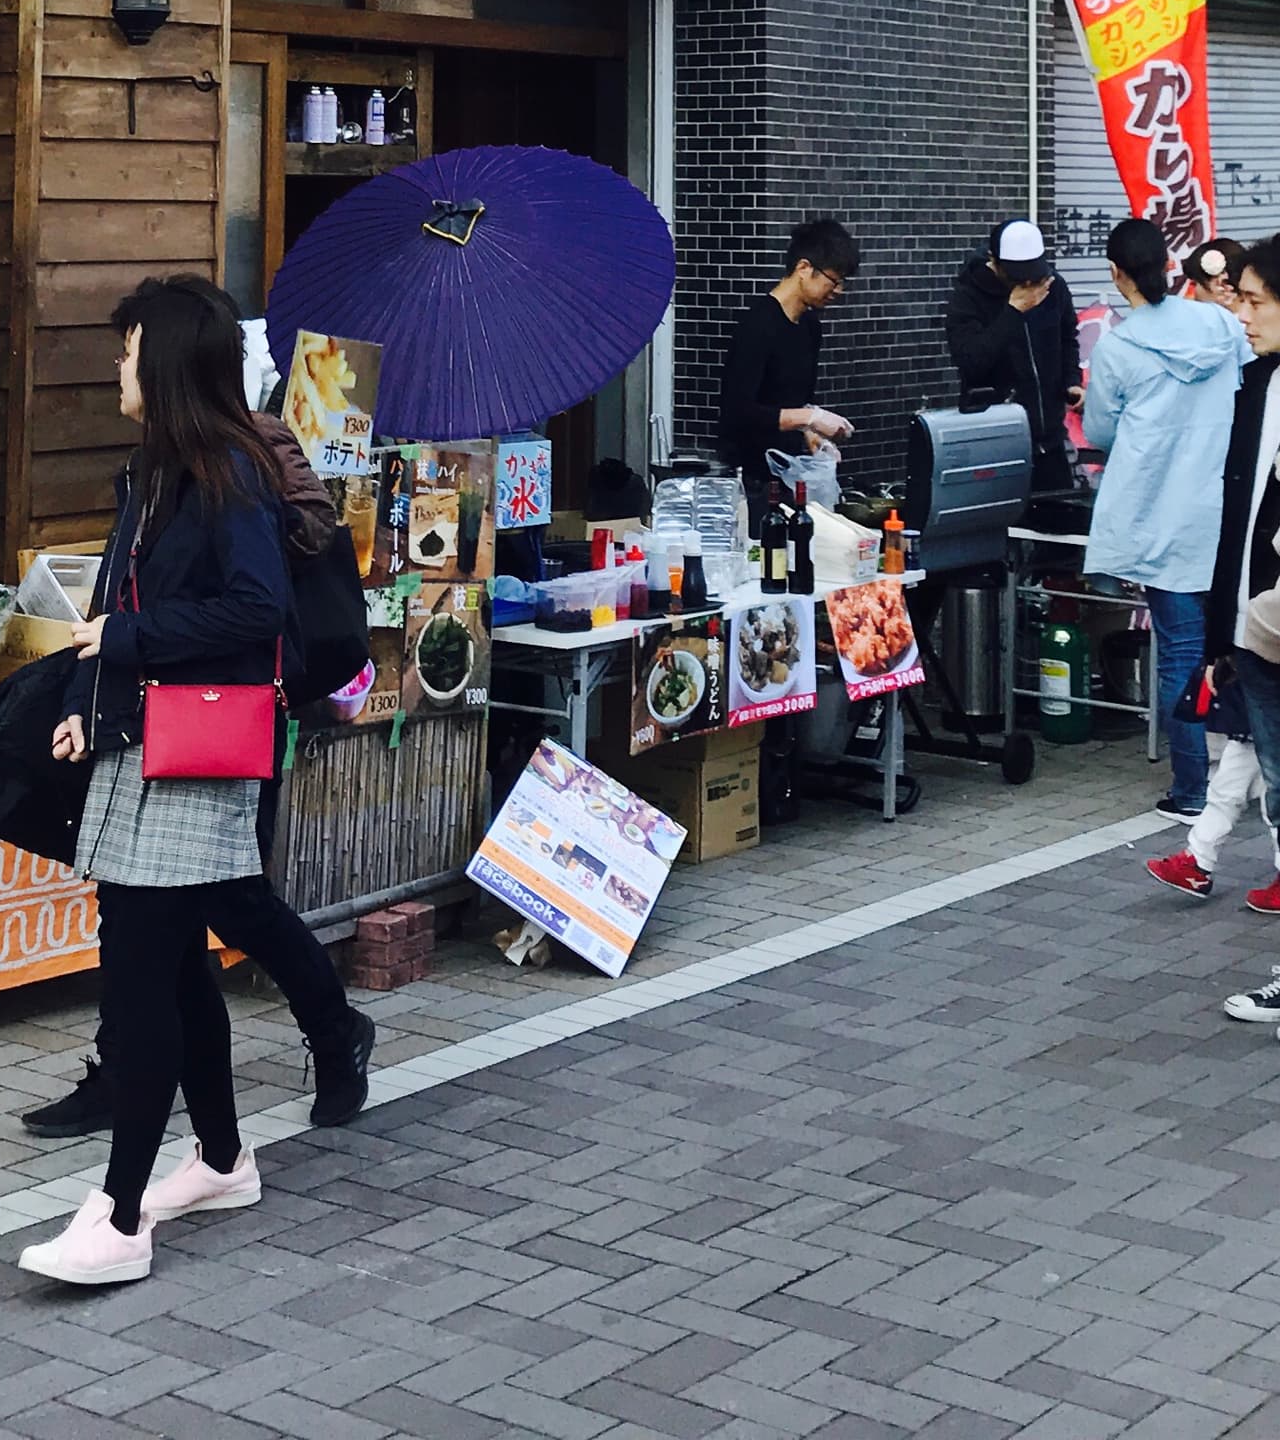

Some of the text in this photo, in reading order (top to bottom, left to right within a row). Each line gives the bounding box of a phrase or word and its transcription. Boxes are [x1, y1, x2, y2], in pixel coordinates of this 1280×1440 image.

[1109, 15, 1188, 67] ジューシ
[1125, 61, 1210, 295] から揚
[323, 438, 367, 468] ポテト
[371, 695, 398, 713] ¥300
[476, 859, 556, 921] facebook
